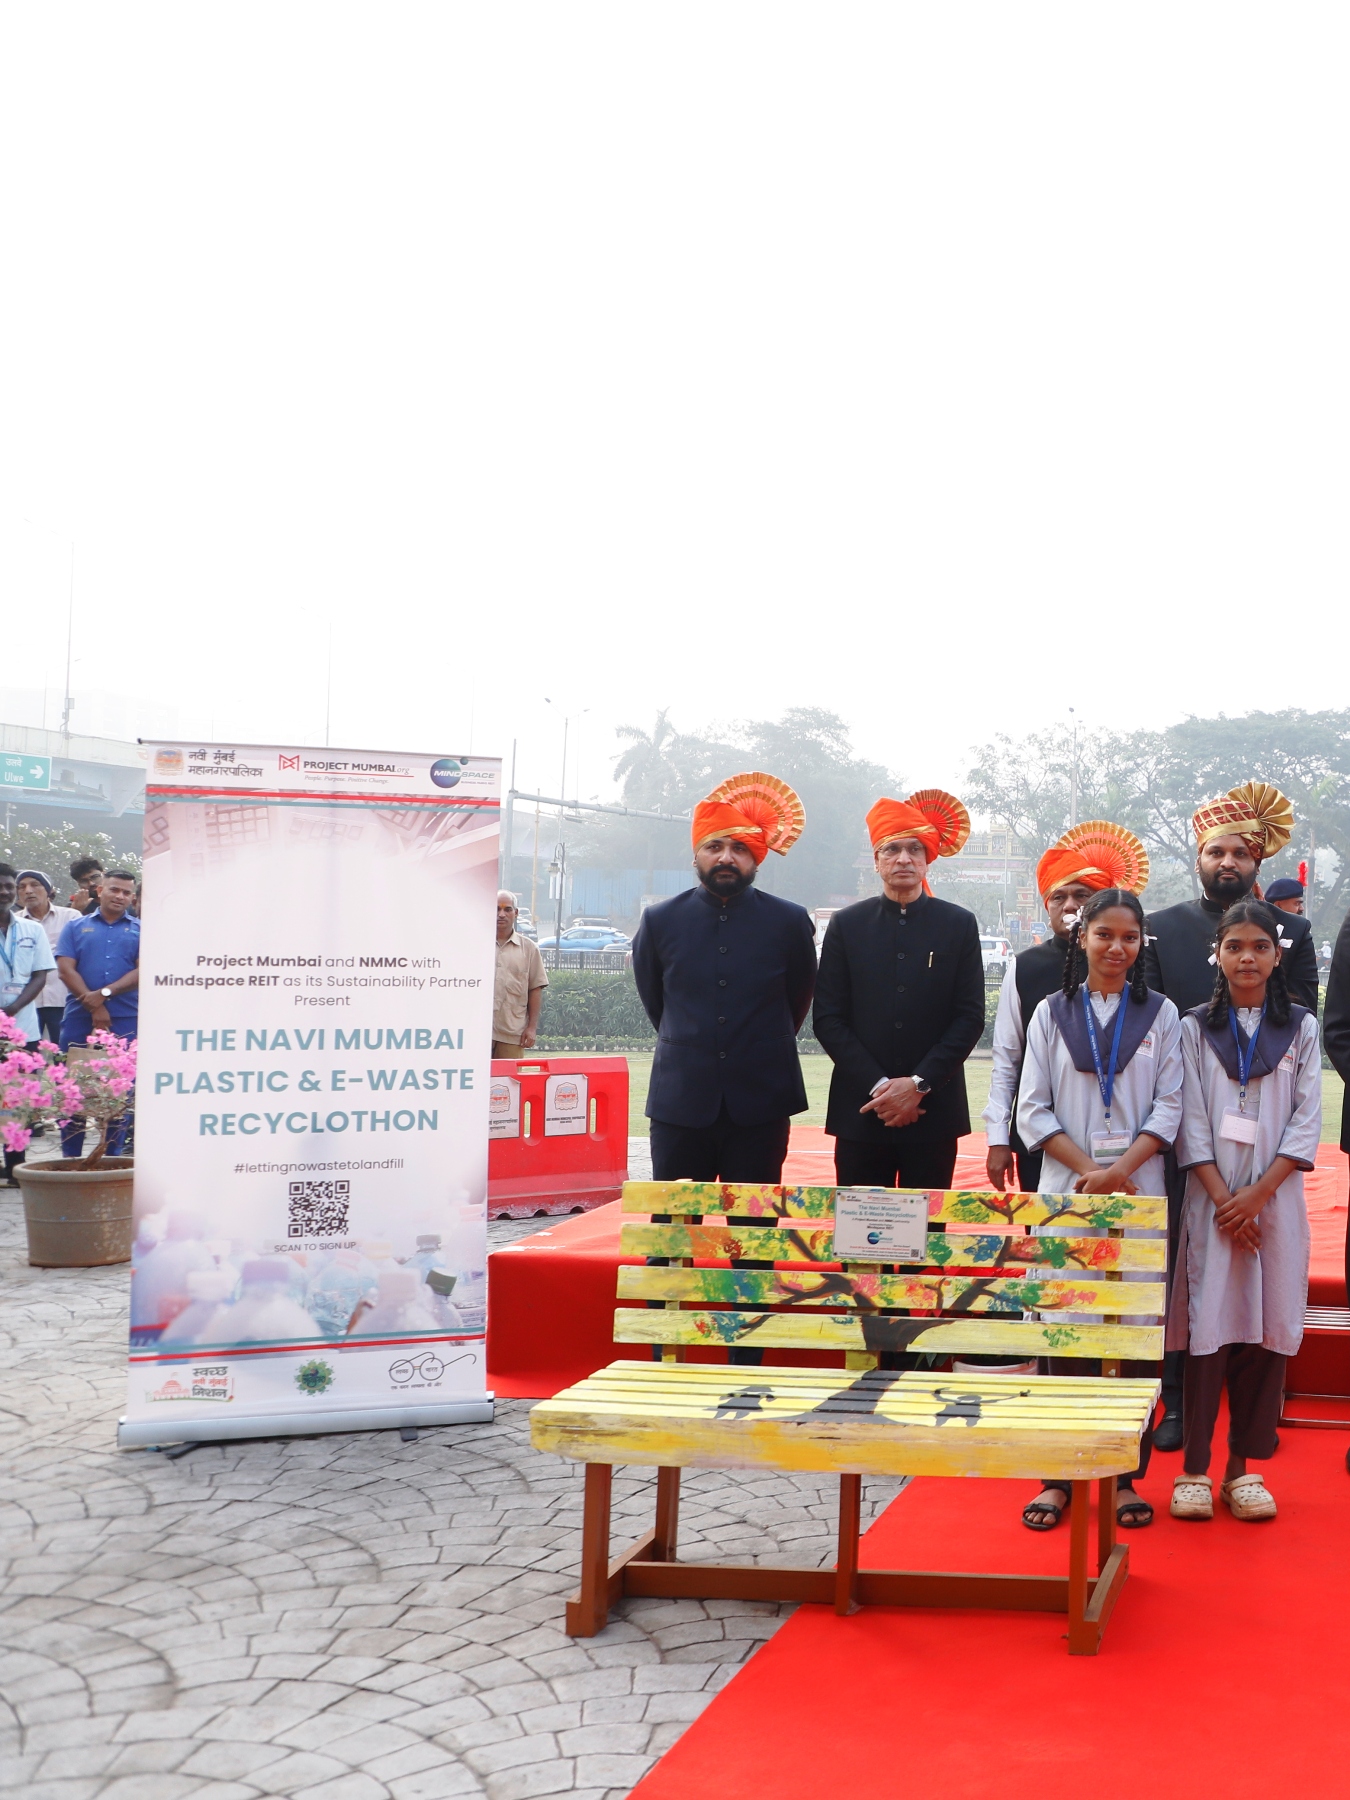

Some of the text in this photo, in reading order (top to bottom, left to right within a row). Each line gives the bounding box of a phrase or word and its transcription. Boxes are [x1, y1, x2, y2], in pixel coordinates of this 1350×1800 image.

[188, 749, 236, 765] नवी मुंबई
[188, 764, 264, 778] महानगरपालिका
[303, 760, 410, 775] PROJECT MUMBAI.org
[434, 770, 495, 778] MINDSPACE
[4, 772, 24, 783] Ulwe
[196, 956, 441, 969] Project Mumbai and NMMC with
[154, 975, 482, 990] Mindspace REIT as its Sustainability Partner
[294, 995, 351, 1006] Present
[175, 1028, 464, 1052] THE NAVI MUMBAI
[154, 1068, 474, 1094] PLASTIC & E-WASTE
[199, 1110, 438, 1136] RECYCLOTHON
[233, 1158, 404, 1175] #lettingnowastetolandfill
[319, 1242, 342, 1251] SIGN
[192, 1366, 228, 1377] स्वच्छ
[192, 1385, 227, 1398] मिशन
